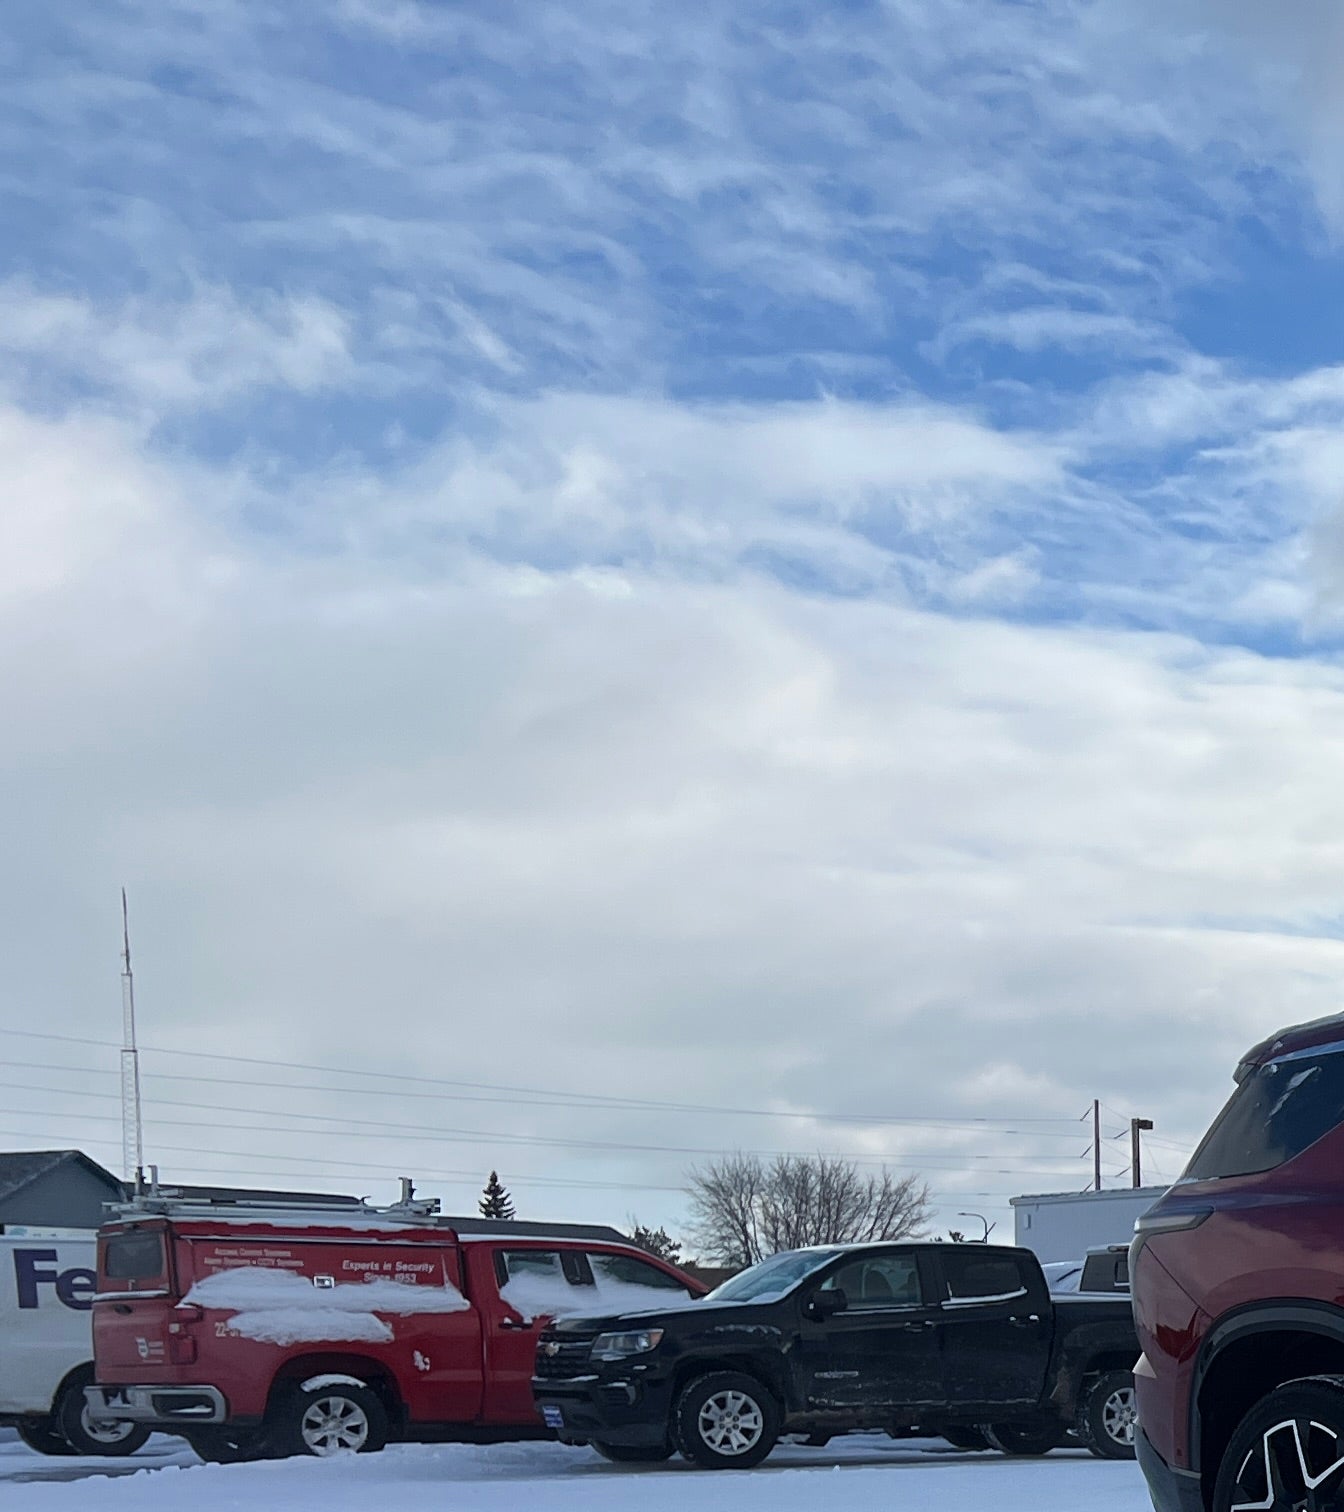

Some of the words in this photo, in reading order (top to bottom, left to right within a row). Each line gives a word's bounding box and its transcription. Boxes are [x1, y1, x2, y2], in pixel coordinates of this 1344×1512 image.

[342, 1259, 380, 1272] Experts
[383, 1261, 393, 1272] in
[395, 1261, 435, 1274] Security
[13, 1249, 97, 1310] Fe
[394, 1272, 417, 1284] 1953
